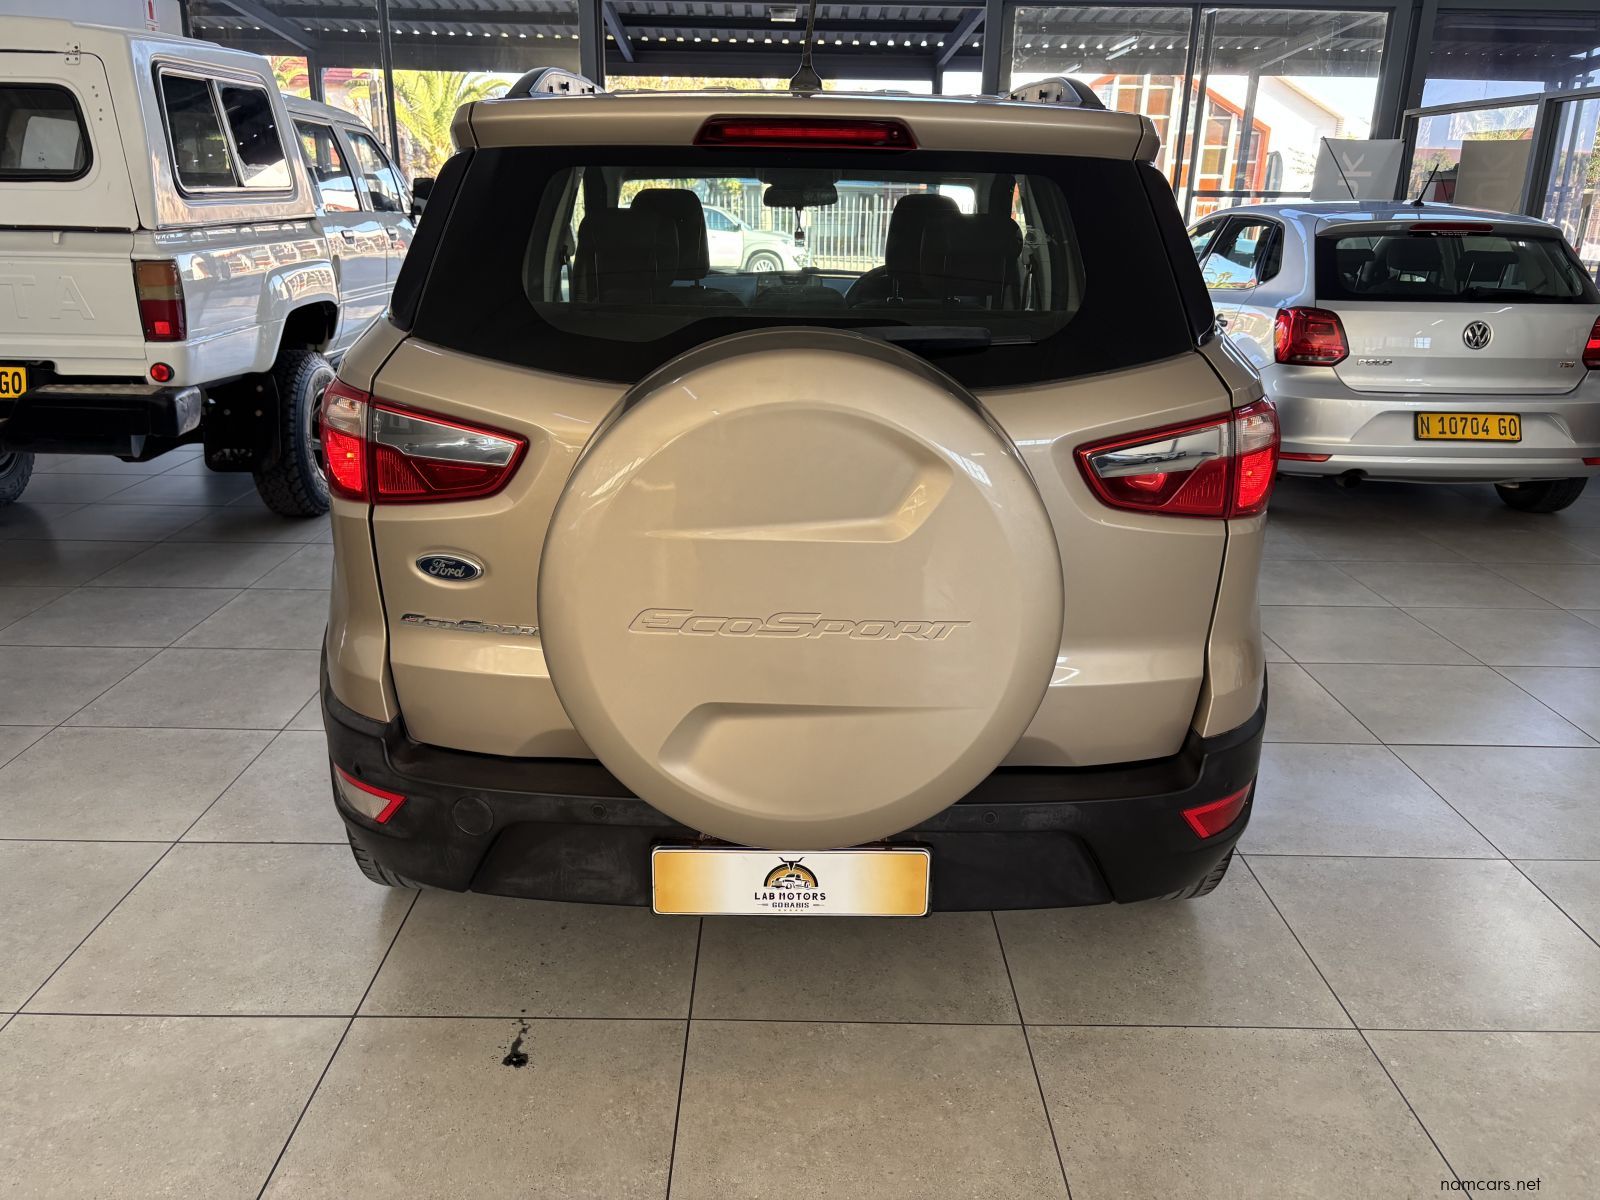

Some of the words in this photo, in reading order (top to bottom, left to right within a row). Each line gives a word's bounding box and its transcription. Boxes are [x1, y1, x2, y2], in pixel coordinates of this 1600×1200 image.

[0, 371, 22, 394] GO
[1420, 416, 1430, 435] N
[1438, 417, 1490, 436] 10704
[1498, 418, 1518, 436] GO
[429, 558, 466, 578] Ford
[754, 892, 775, 900] LAB
[779, 892, 826, 901] MOTORS
